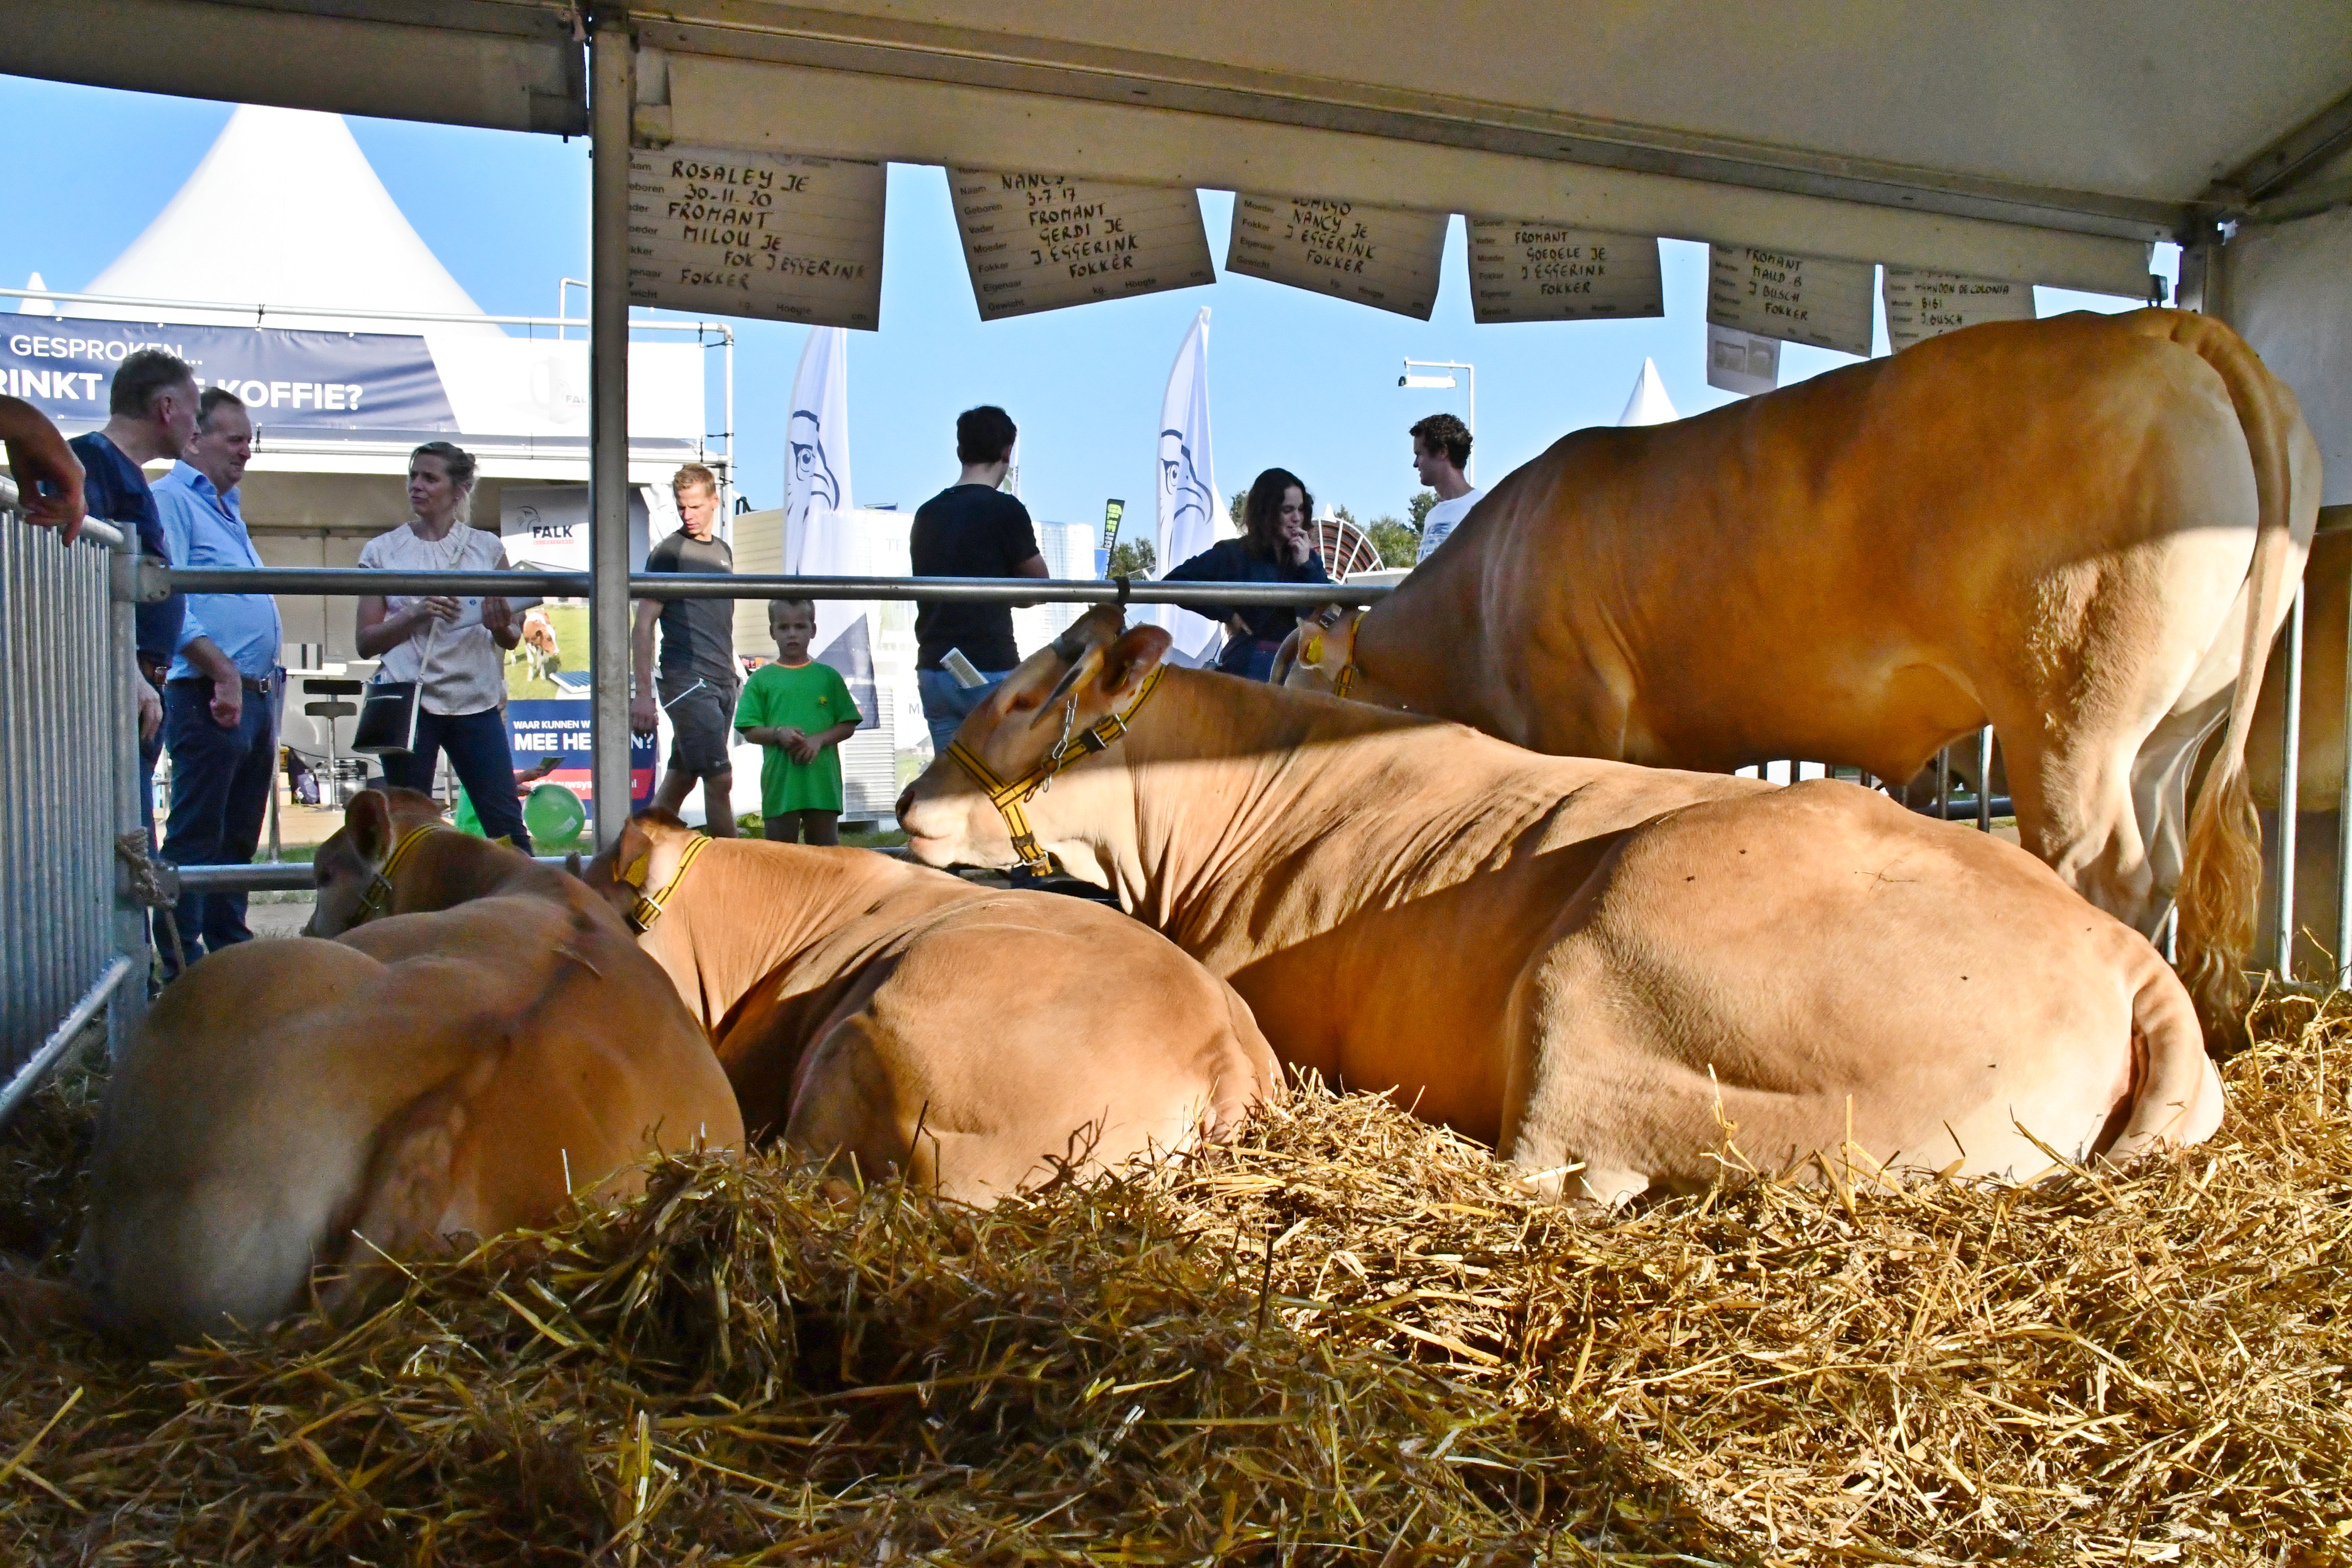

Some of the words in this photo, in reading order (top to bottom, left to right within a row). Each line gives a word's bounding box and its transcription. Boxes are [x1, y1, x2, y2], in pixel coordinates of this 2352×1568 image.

[629, 161, 651, 171] aam
[672, 160, 773, 189] ROSALEY
[780, 174, 810, 192] JE
[629, 182, 664, 193] eboren
[960, 186, 987, 196] Naam
[668, 201, 774, 230] FROMANT
[964, 203, 1003, 215] Geboren
[1029, 202, 1106, 227] FROMANT
[1242, 218, 1271, 231] Fokker
[1293, 208, 1342, 234] NANCY
[629, 225, 659, 235] oeder
[969, 224, 994, 234] Vader
[1039, 223, 1090, 247] GERDI
[1104, 218, 1125, 234] JE
[684, 225, 750, 248] MILOU
[1515, 231, 1569, 245] FROMANT
[973, 242, 1008, 254] Moeder
[1050, 234, 1139, 262] EGGERINK
[724, 250, 757, 267] FOK
[1307, 249, 1364, 274] FOKKER
[978, 262, 1010, 273] Fokker
[1069, 253, 1133, 279] FOKKER
[681, 268, 749, 291] FOKKER
[983, 280, 1022, 292] Eigenaar
[1124, 277, 1157, 289] Hoogte
[629, 289, 657, 299] wicht
[1541, 281, 1590, 295] FOKKER
[988, 298, 1025, 311] Gewicht
[1765, 302, 1808, 321] FOKKER
[566, 395, 587, 403] FAL
[533, 525, 573, 539] FALK
[513, 720, 540, 730] WAAR
[541, 719, 580, 729] KUNNEN
[580, 719, 591, 729] W
[514, 732, 558, 751] MEE
